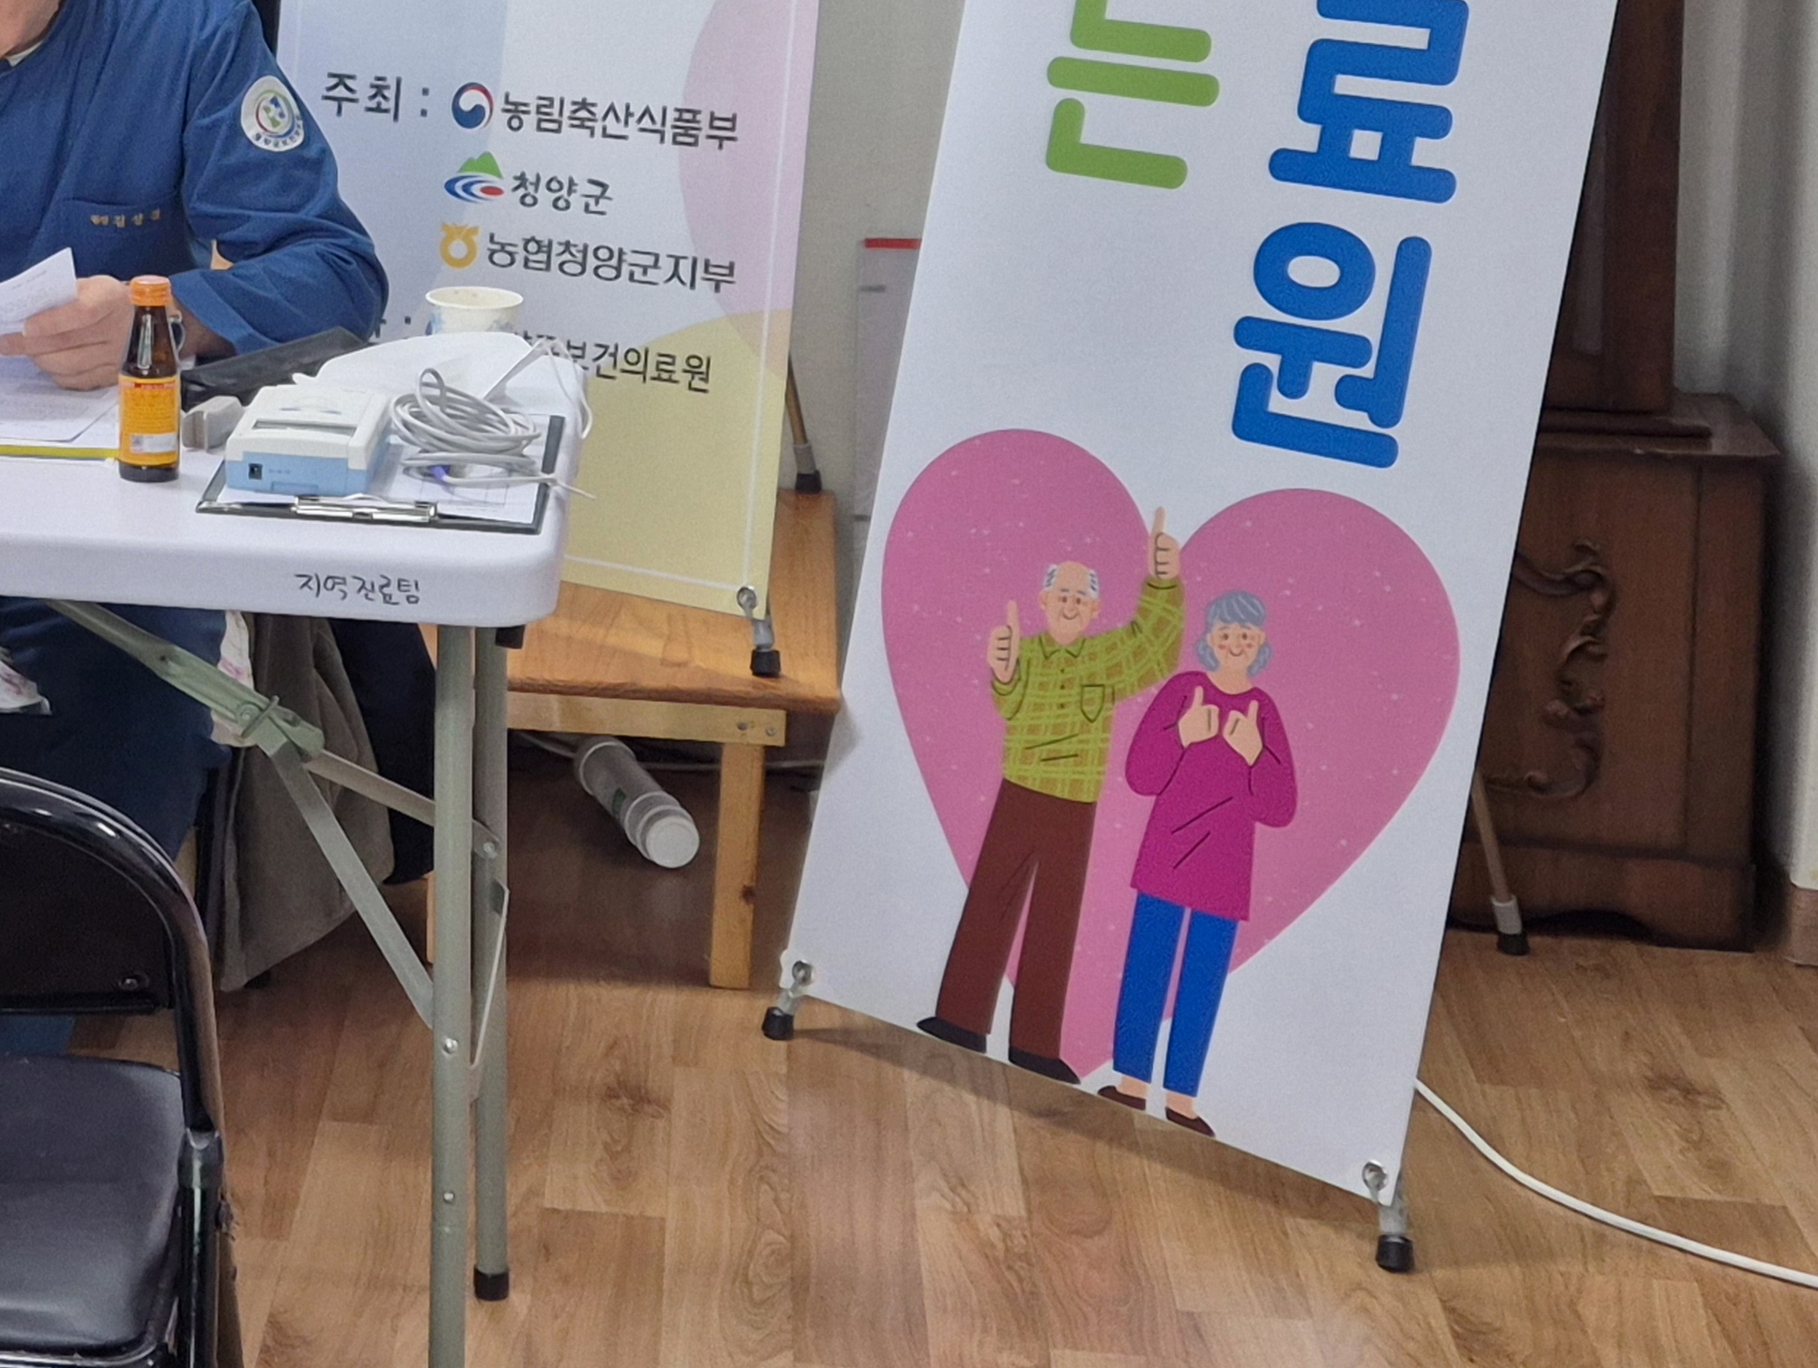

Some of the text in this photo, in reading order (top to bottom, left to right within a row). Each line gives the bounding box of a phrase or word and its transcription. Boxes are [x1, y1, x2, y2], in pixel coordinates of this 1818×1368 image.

[321, 72, 401, 122] 주최
[500, 91, 738, 150] 농림축산식품부
[511, 171, 614, 216] 청양군
[485, 232, 736, 294] 농협청양군지부
